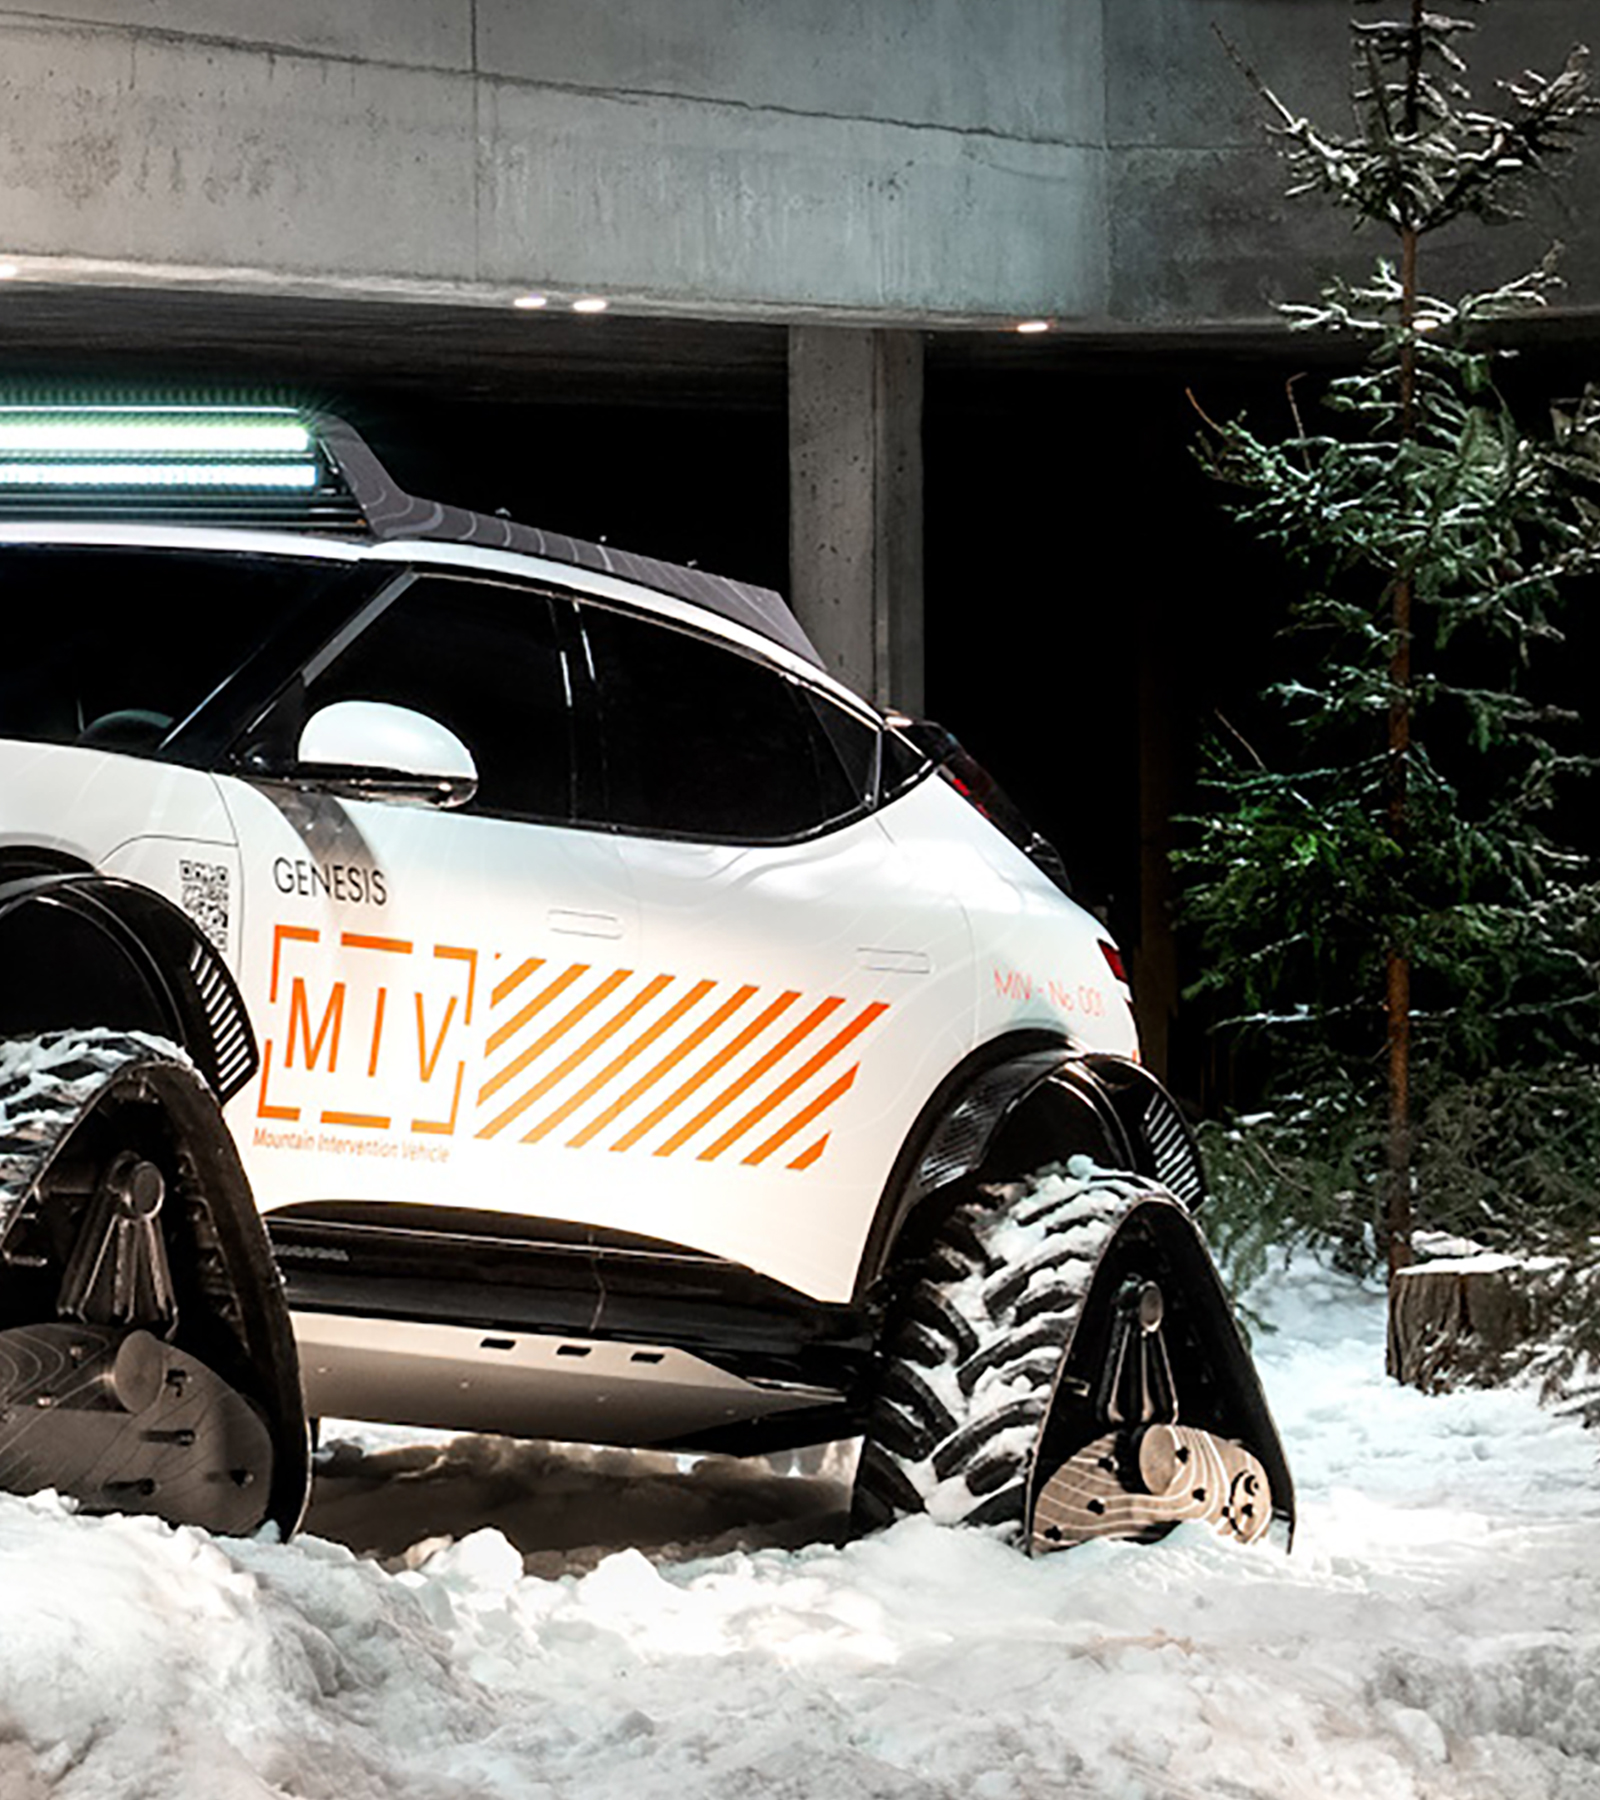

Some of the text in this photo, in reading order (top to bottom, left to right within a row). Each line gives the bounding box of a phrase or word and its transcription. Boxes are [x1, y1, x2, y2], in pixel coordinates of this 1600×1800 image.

[273, 857, 388, 906] GENESIS
[284, 976, 459, 1083] MIV
[252, 1127, 451, 1163] Mountain Intervention Vehicle
